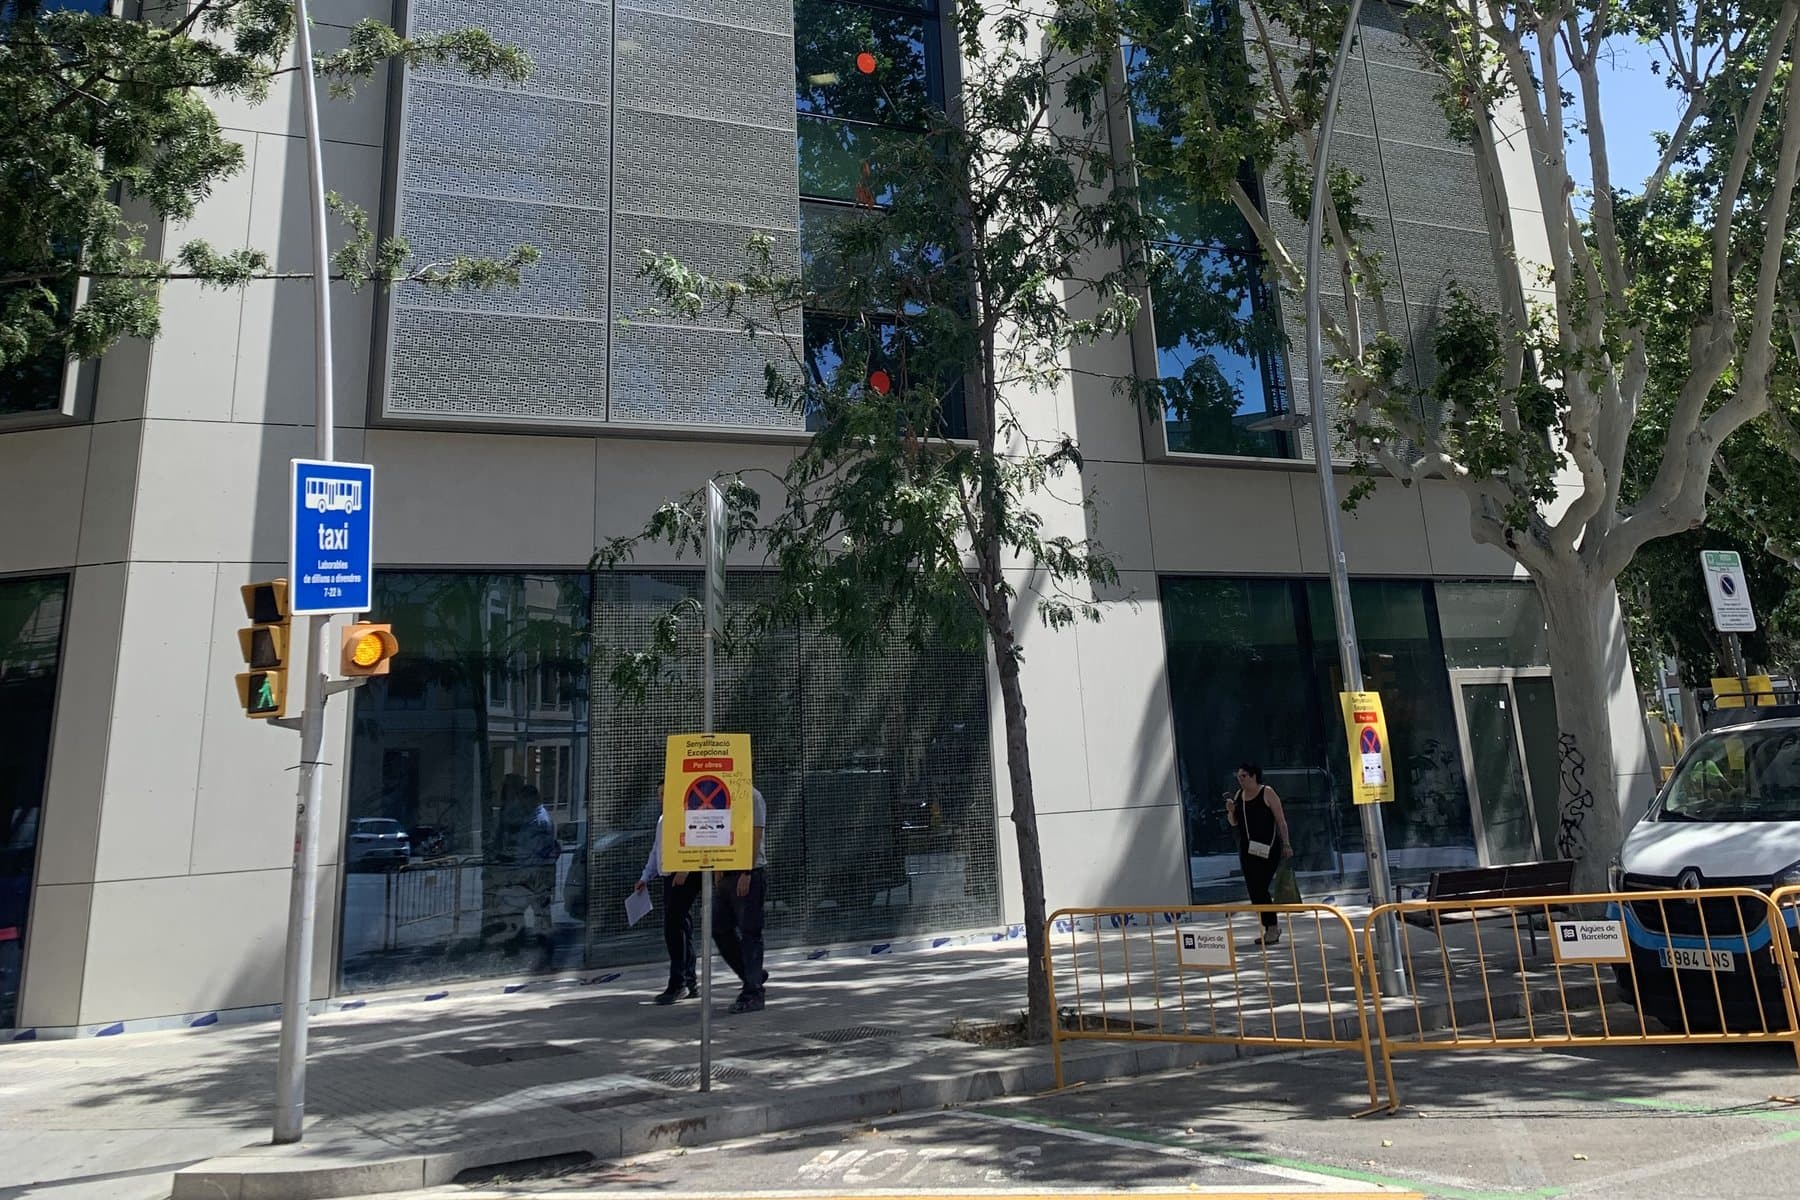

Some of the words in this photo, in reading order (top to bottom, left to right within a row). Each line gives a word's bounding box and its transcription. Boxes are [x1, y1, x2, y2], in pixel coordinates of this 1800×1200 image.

[318, 522, 349, 550] taxi
[317, 559, 349, 569] Laborables
[303, 574, 311, 584] de
[687, 749, 729, 757] Excepcional
[692, 761, 703, 769] Per
[1581, 932, 1618, 940] Barcelona
[1702, 952, 1730, 968] LNS
